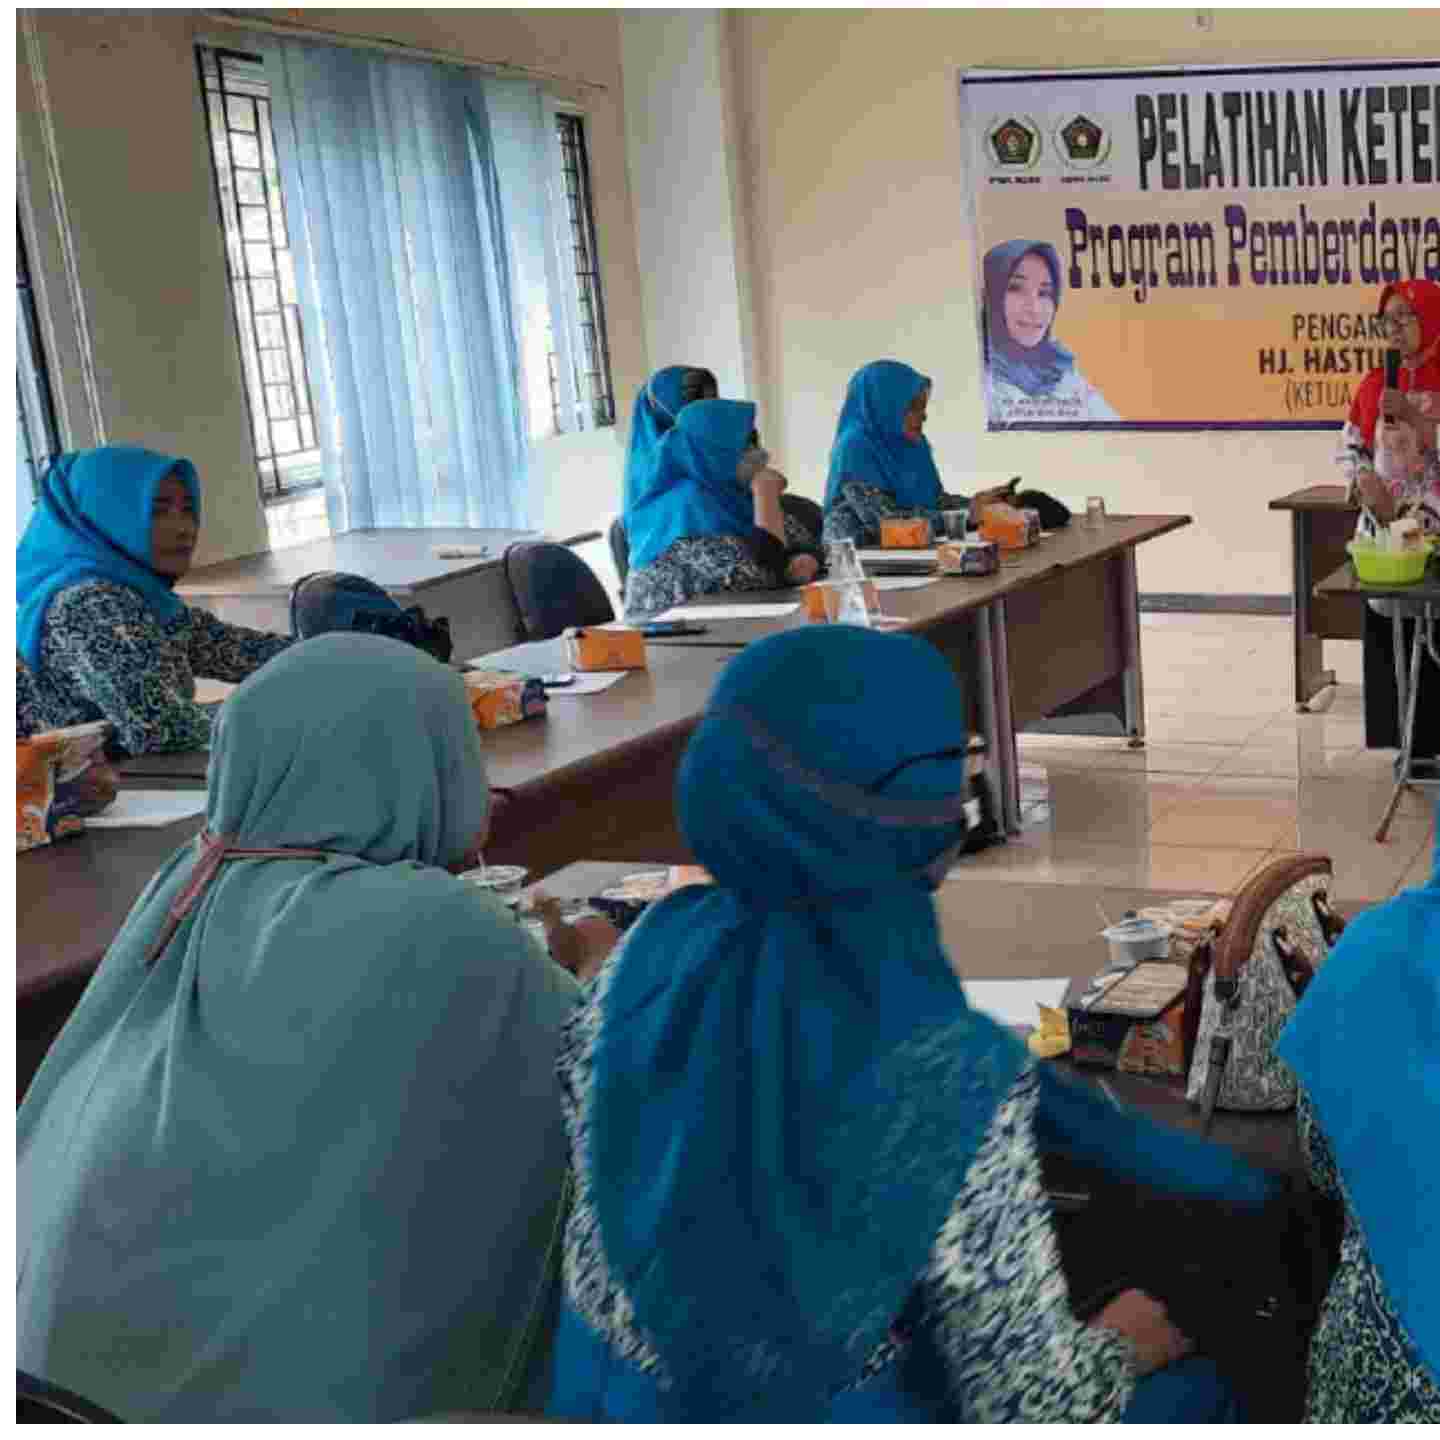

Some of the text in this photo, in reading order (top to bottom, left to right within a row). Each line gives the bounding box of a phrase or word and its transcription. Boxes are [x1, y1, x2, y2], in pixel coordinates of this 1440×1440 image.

[1135, 88, 1328, 191] PELATIHAN
[1064, 207, 1218, 303] Program
[1257, 347, 1295, 374] HJ.
